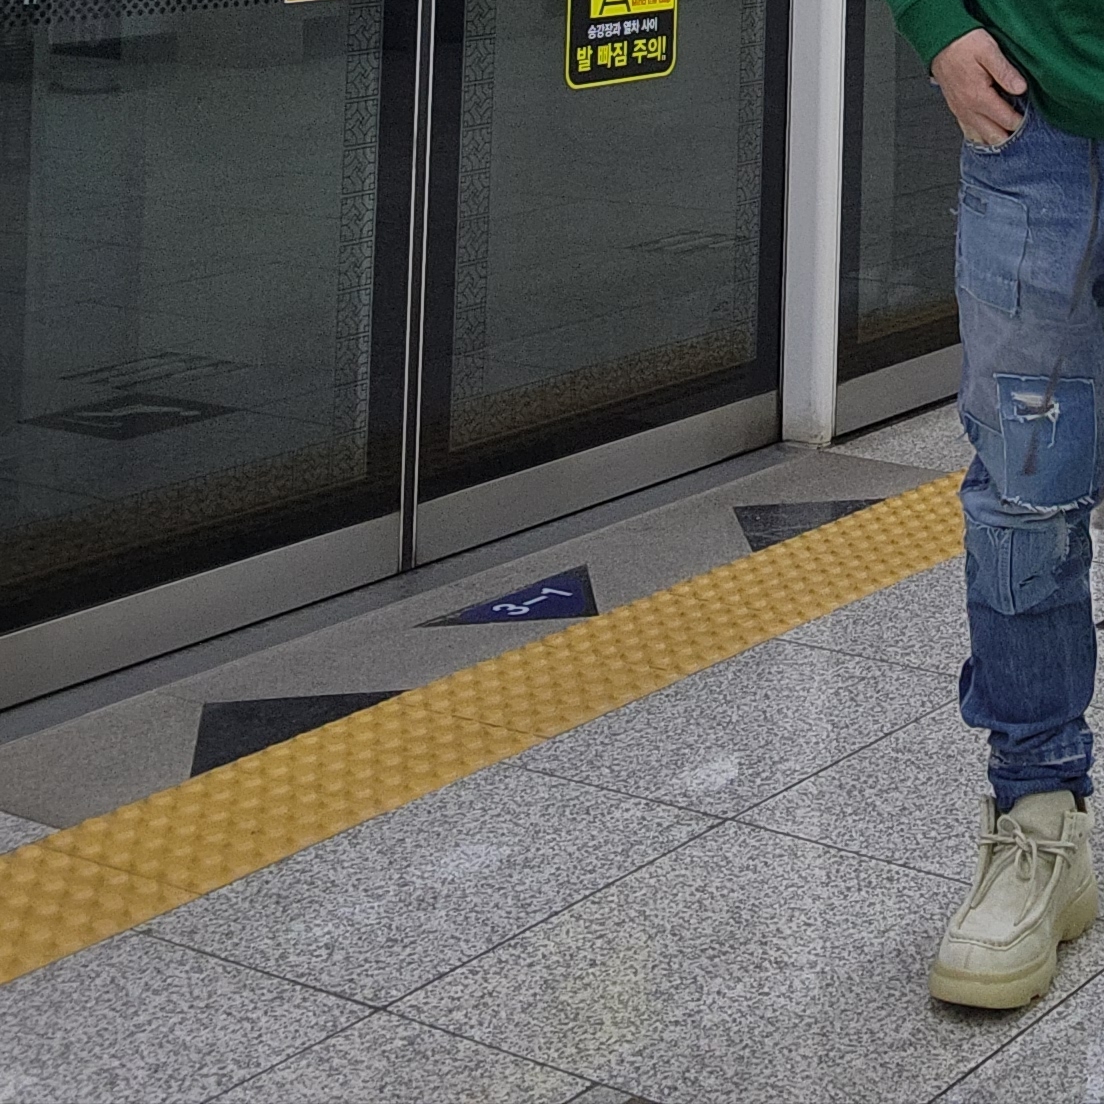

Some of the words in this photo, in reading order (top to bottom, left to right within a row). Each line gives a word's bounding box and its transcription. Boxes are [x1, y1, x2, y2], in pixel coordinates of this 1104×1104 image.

[588, 21, 621, 39] 승강장과
[623, 19, 640, 35] 열차
[641, 17, 658, 32] 사이
[576, 46, 593, 72] 발
[597, 41, 628, 69] 빠짐
[632, 36, 667, 65] 주의!
[493, 587, 573, 616] 3-1
